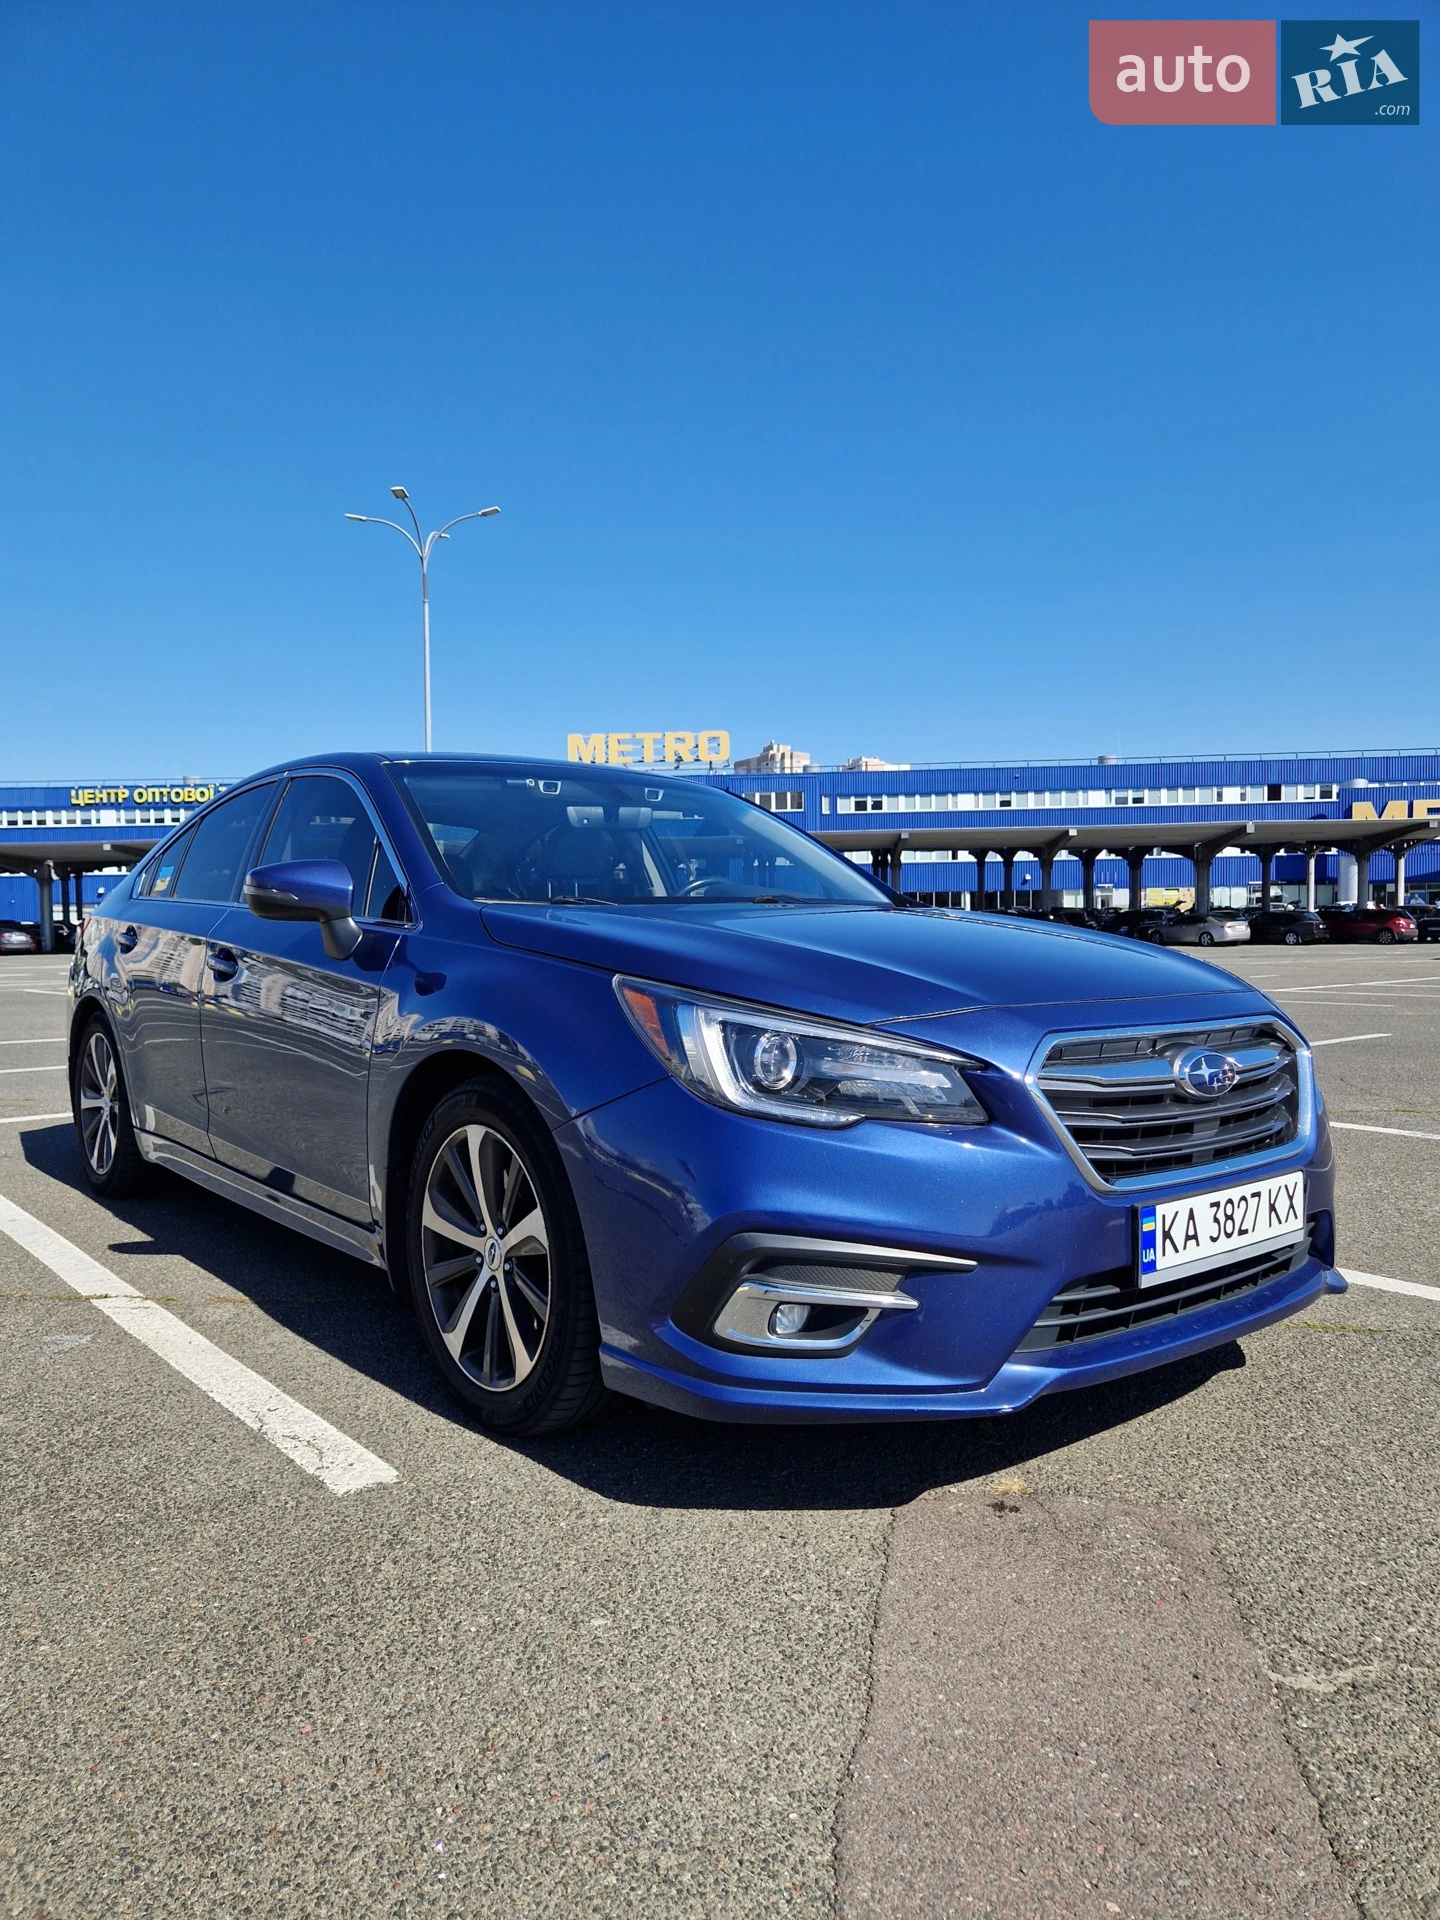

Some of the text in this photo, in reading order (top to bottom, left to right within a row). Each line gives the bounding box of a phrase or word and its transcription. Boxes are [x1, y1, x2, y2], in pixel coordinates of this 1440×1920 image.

[567, 730, 730, 763] METRO
[70, 787, 129, 806] ЦЕНТР
[1161, 1182, 1299, 1257] KA 3827 KX
[1142, 1249, 1155, 1263] UA
